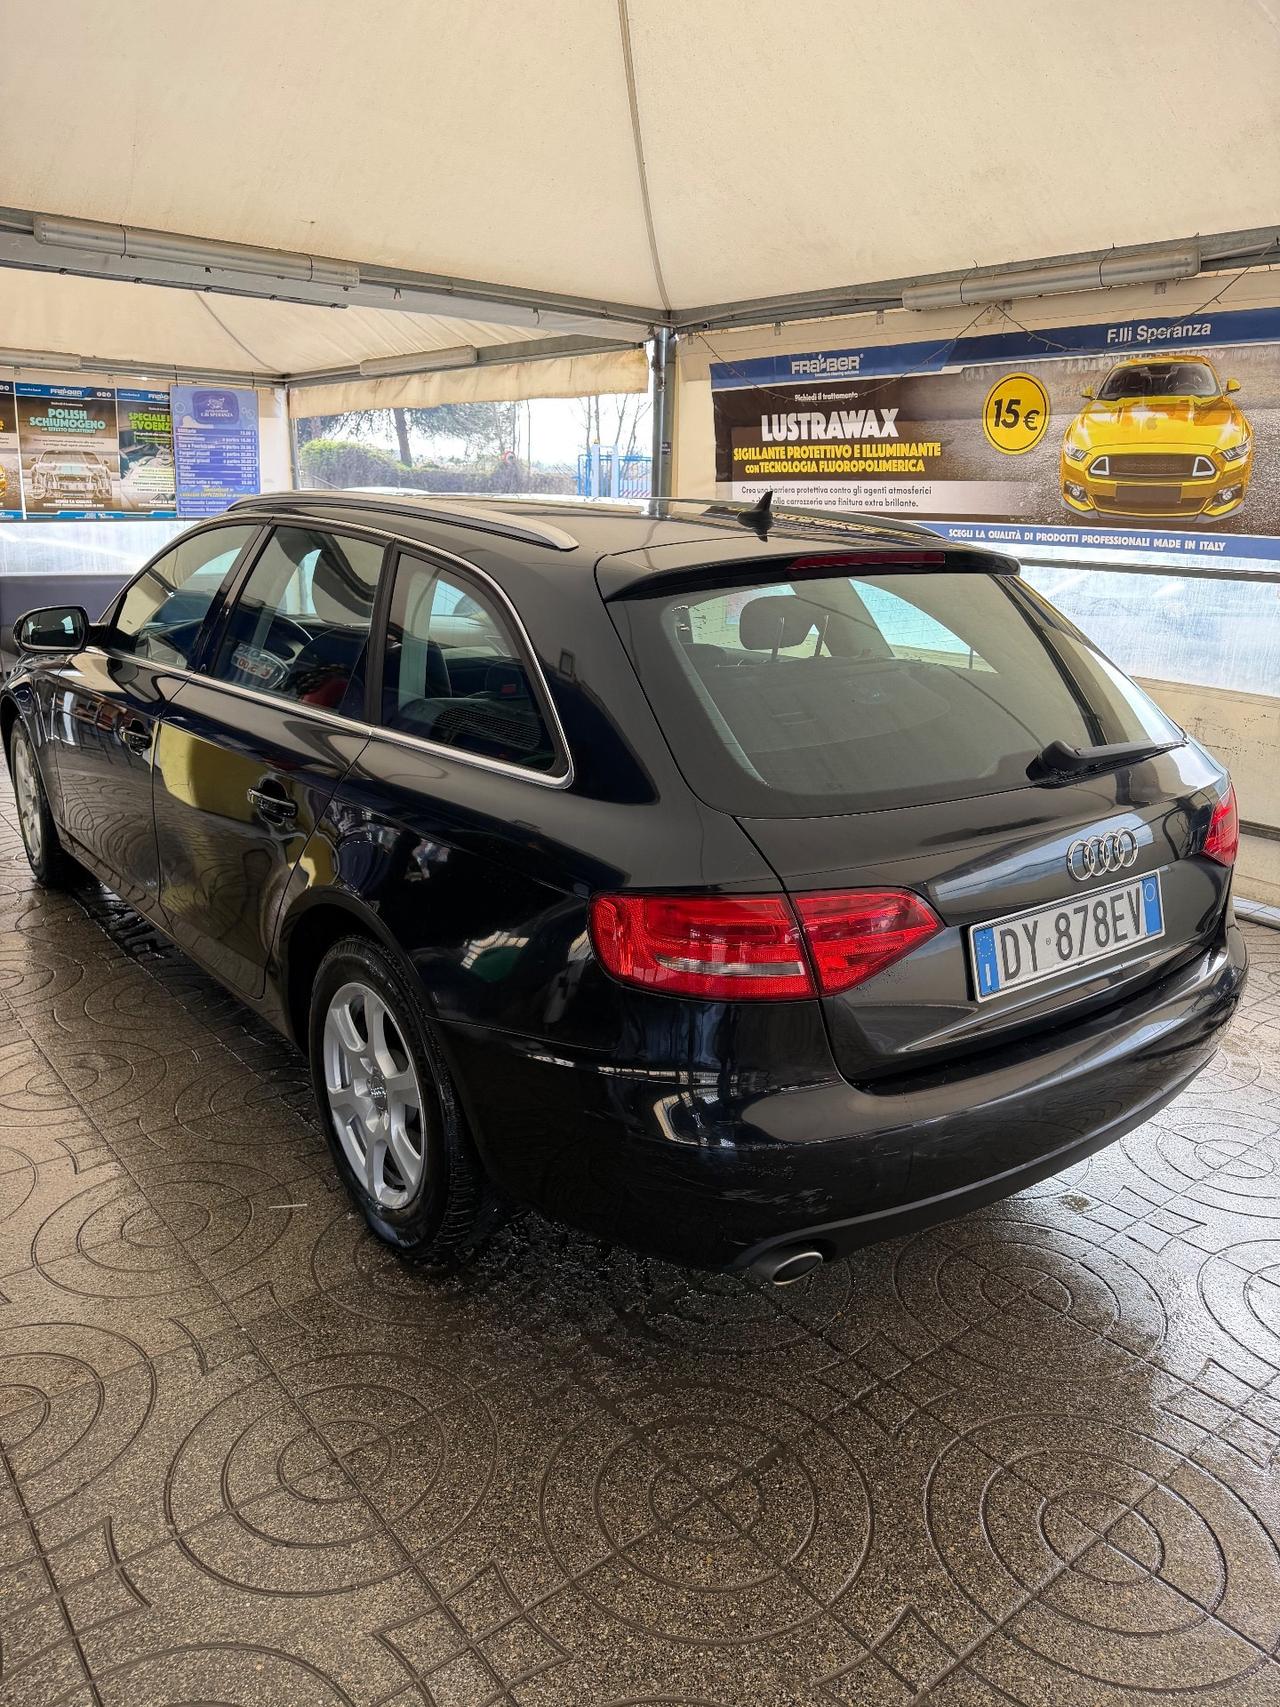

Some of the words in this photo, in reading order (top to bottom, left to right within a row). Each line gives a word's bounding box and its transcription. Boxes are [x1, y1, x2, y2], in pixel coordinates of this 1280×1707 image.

[1107, 327, 1132, 344] F.lli
[1136, 322, 1212, 344] Speranza
[48, 408, 88, 420] POLISH
[128, 412, 167, 422] SPECIALE
[29, 416, 106, 430] SCHIUMOGENO
[761, 408, 900, 442] LUSTRAWAX
[733, 445, 786, 461] SIGILLANTE
[787, 444, 852, 460] PROTETTIVO
[853, 444, 862, 458] E
[862, 442, 941, 458] ILLUMINANTE
[759, 461, 819, 473] TECNOLOGIA
[819, 459, 925, 473] FLUOROPOLIMERICA
[741, 486, 756, 494] Crea
[769, 485, 795, 494] barriera
[796, 486, 829, 495] protettiva
[853, 485, 862, 496] gli
[863, 486, 887, 496] agenti
[888, 485, 932, 495] atmosferici
[786, 497, 823, 505] carrozzeria
[837, 497, 863, 506] finitura
[864, 499, 884, 507] extra
[884, 498, 919, 507] brillante.
[948, 528, 973, 538] SCEGLI
[975, 530, 986, 539] LA
[988, 529, 1022, 540] QUALITÀ
[1024, 532, 1034, 541] DI
[1036, 533, 1079, 543] PRODOTTI
[1081, 534, 1150, 547] PROFESSIONALI
[1153, 538, 1182, 549] MADE
[1185, 540, 1196, 550] IN
[1199, 541, 1227, 551] ITALY
[1000, 919, 1039, 982] DY
[1055, 887, 1141, 961] 878EV
